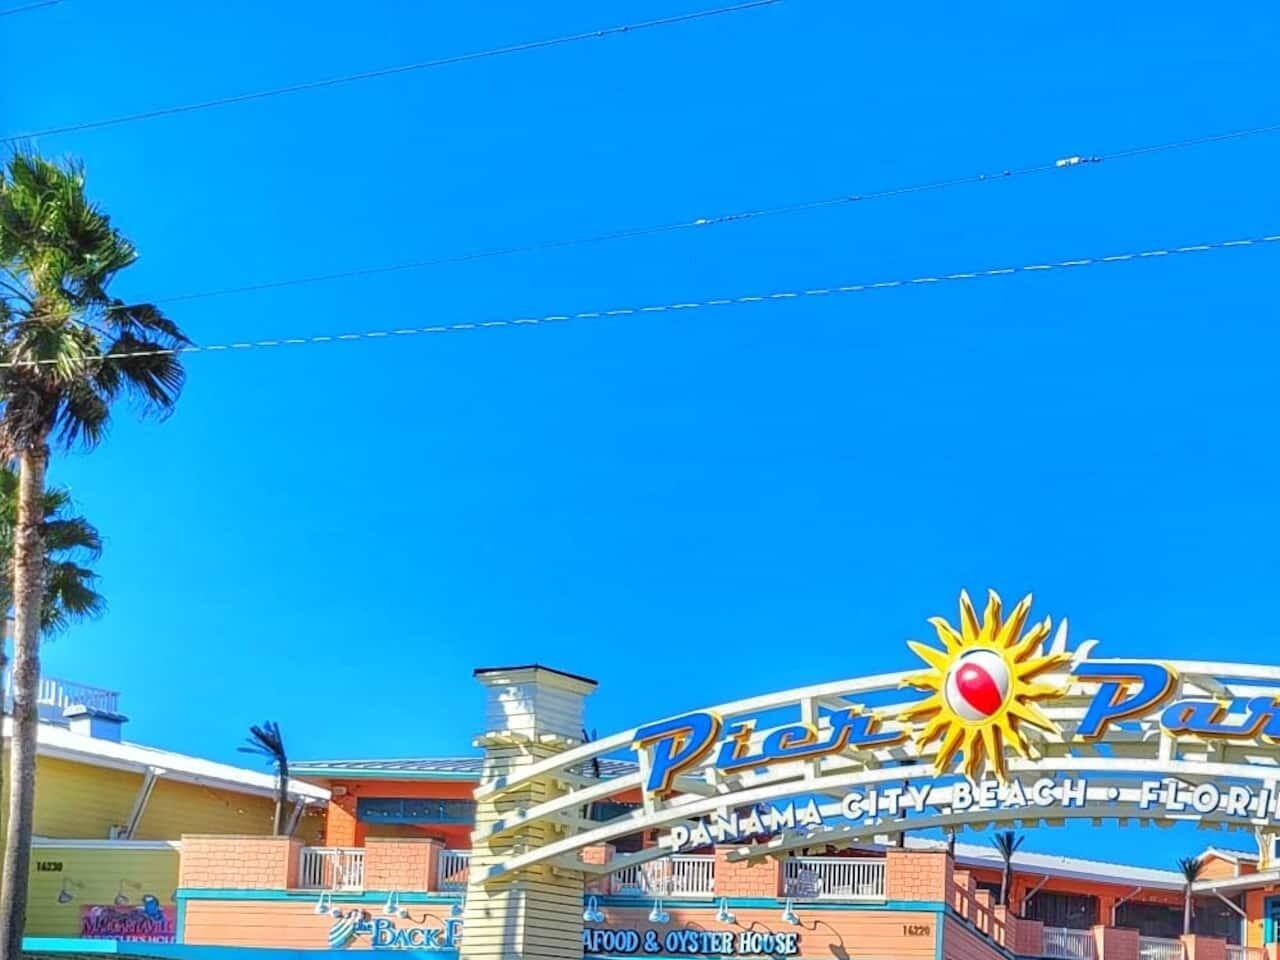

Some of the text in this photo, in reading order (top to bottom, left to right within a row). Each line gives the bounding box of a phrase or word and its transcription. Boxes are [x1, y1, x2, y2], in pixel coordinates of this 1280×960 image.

[632, 708, 912, 796] Pier
[670, 798, 823, 851] PANAMA
[842, 784, 933, 820] CITY
[951, 777, 1088, 811] BEACH
[583, 929, 799, 955] AFOOD & OYSTER HOUSE
